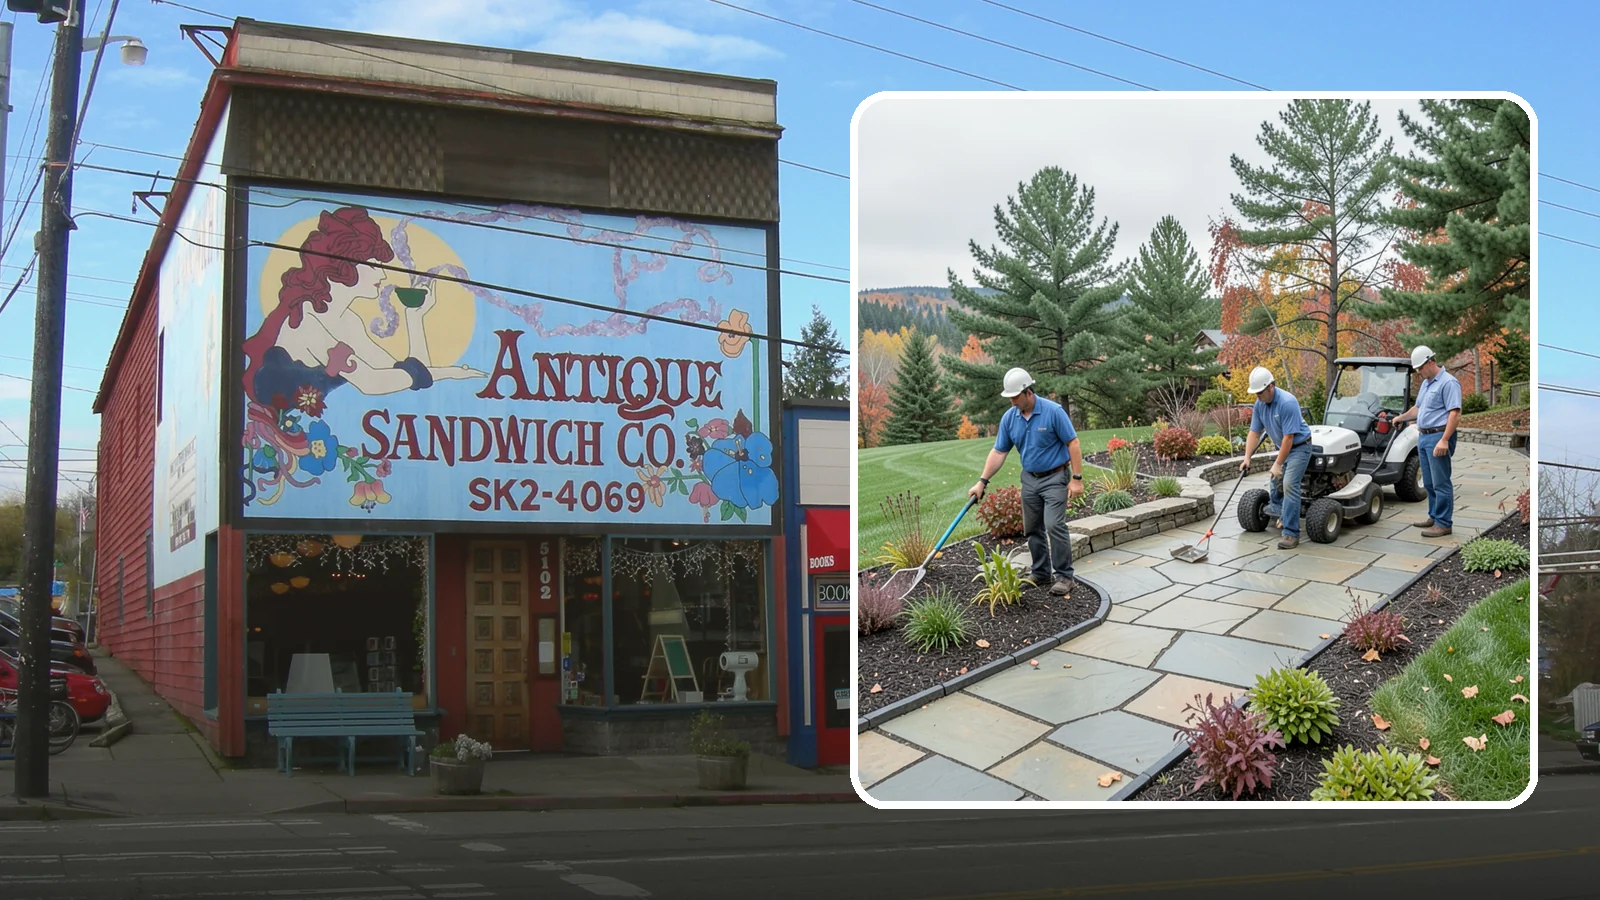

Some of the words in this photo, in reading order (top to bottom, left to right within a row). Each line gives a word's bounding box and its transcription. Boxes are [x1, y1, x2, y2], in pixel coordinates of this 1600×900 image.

[476, 328, 724, 420] ANTIQUE
[361, 408, 604, 467] SANDWICH
[617, 421, 685, 470] CO.
[468, 477, 646, 512] SK2-4069
[540, 541, 551, 600] 5102
[809, 555, 835, 569] BOOKS
